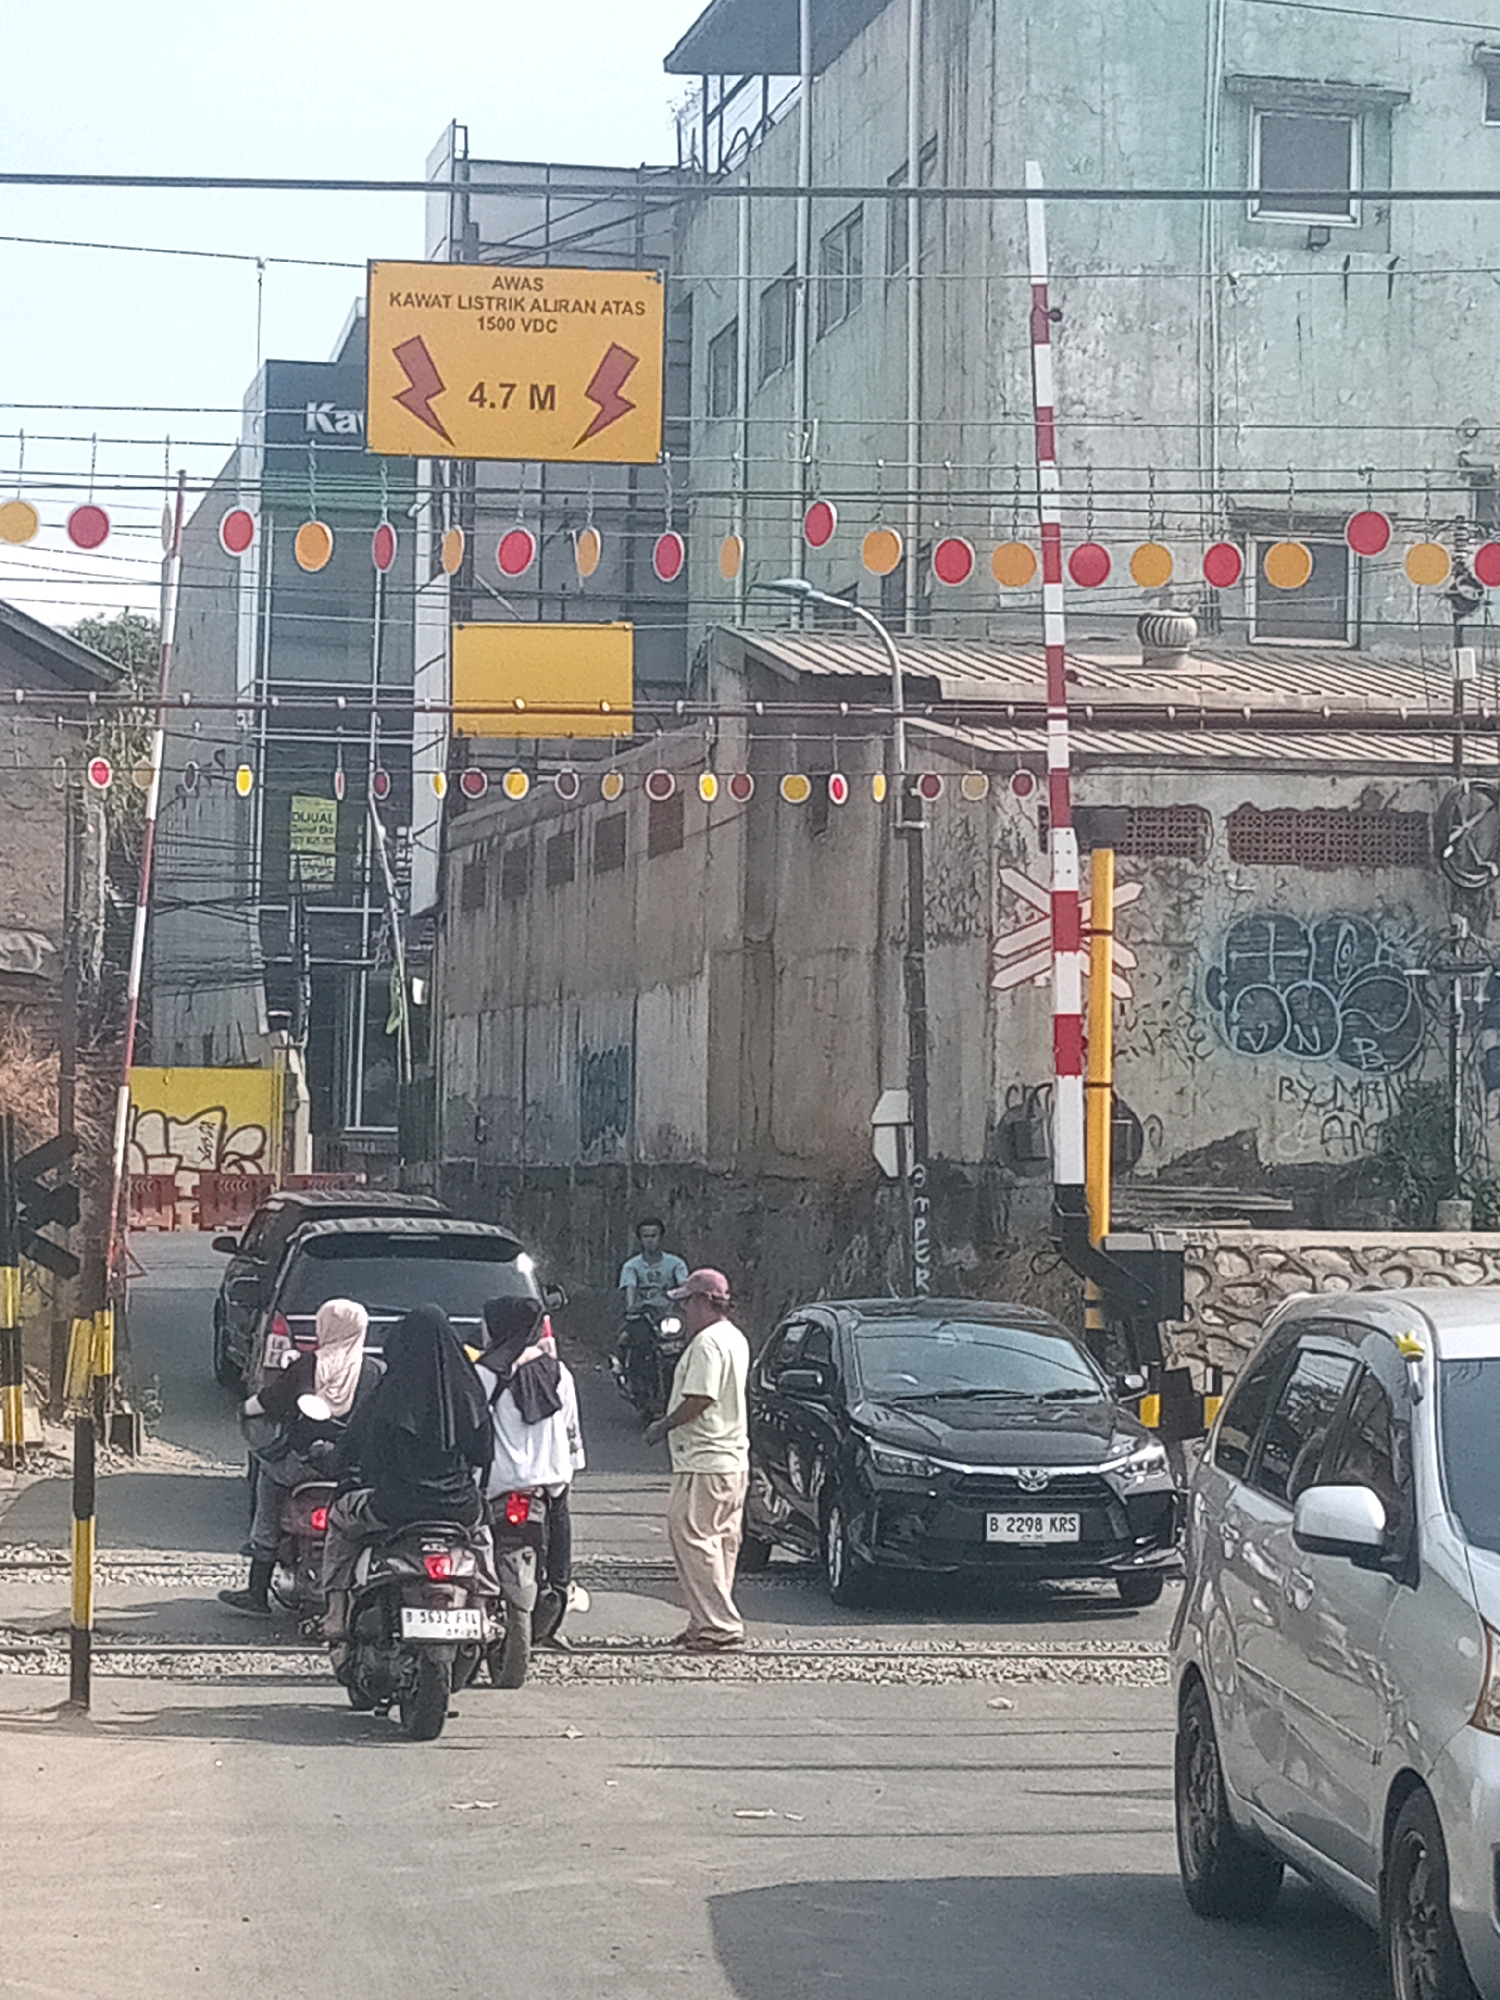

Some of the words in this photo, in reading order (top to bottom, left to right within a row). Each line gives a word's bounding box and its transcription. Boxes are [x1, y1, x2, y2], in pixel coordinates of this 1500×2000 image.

[491, 275, 544, 292] AWAS
[389, 291, 452, 309] KAWAT
[457, 294, 525, 312] LISTRIK
[529, 298, 597, 315] ALIRAN
[600, 300, 646, 316] ATAS
[477, 315, 516, 332] 1500
[520, 317, 558, 334] VDC
[468, 381, 517, 410] 4.7
[529, 383, 556, 411] M
[305, 402, 364, 434] Ka
[990, 1517, 999, 1533] B
[1006, 1517, 1043, 1533] 2298
[1049, 1517, 1077, 1533] KRS
